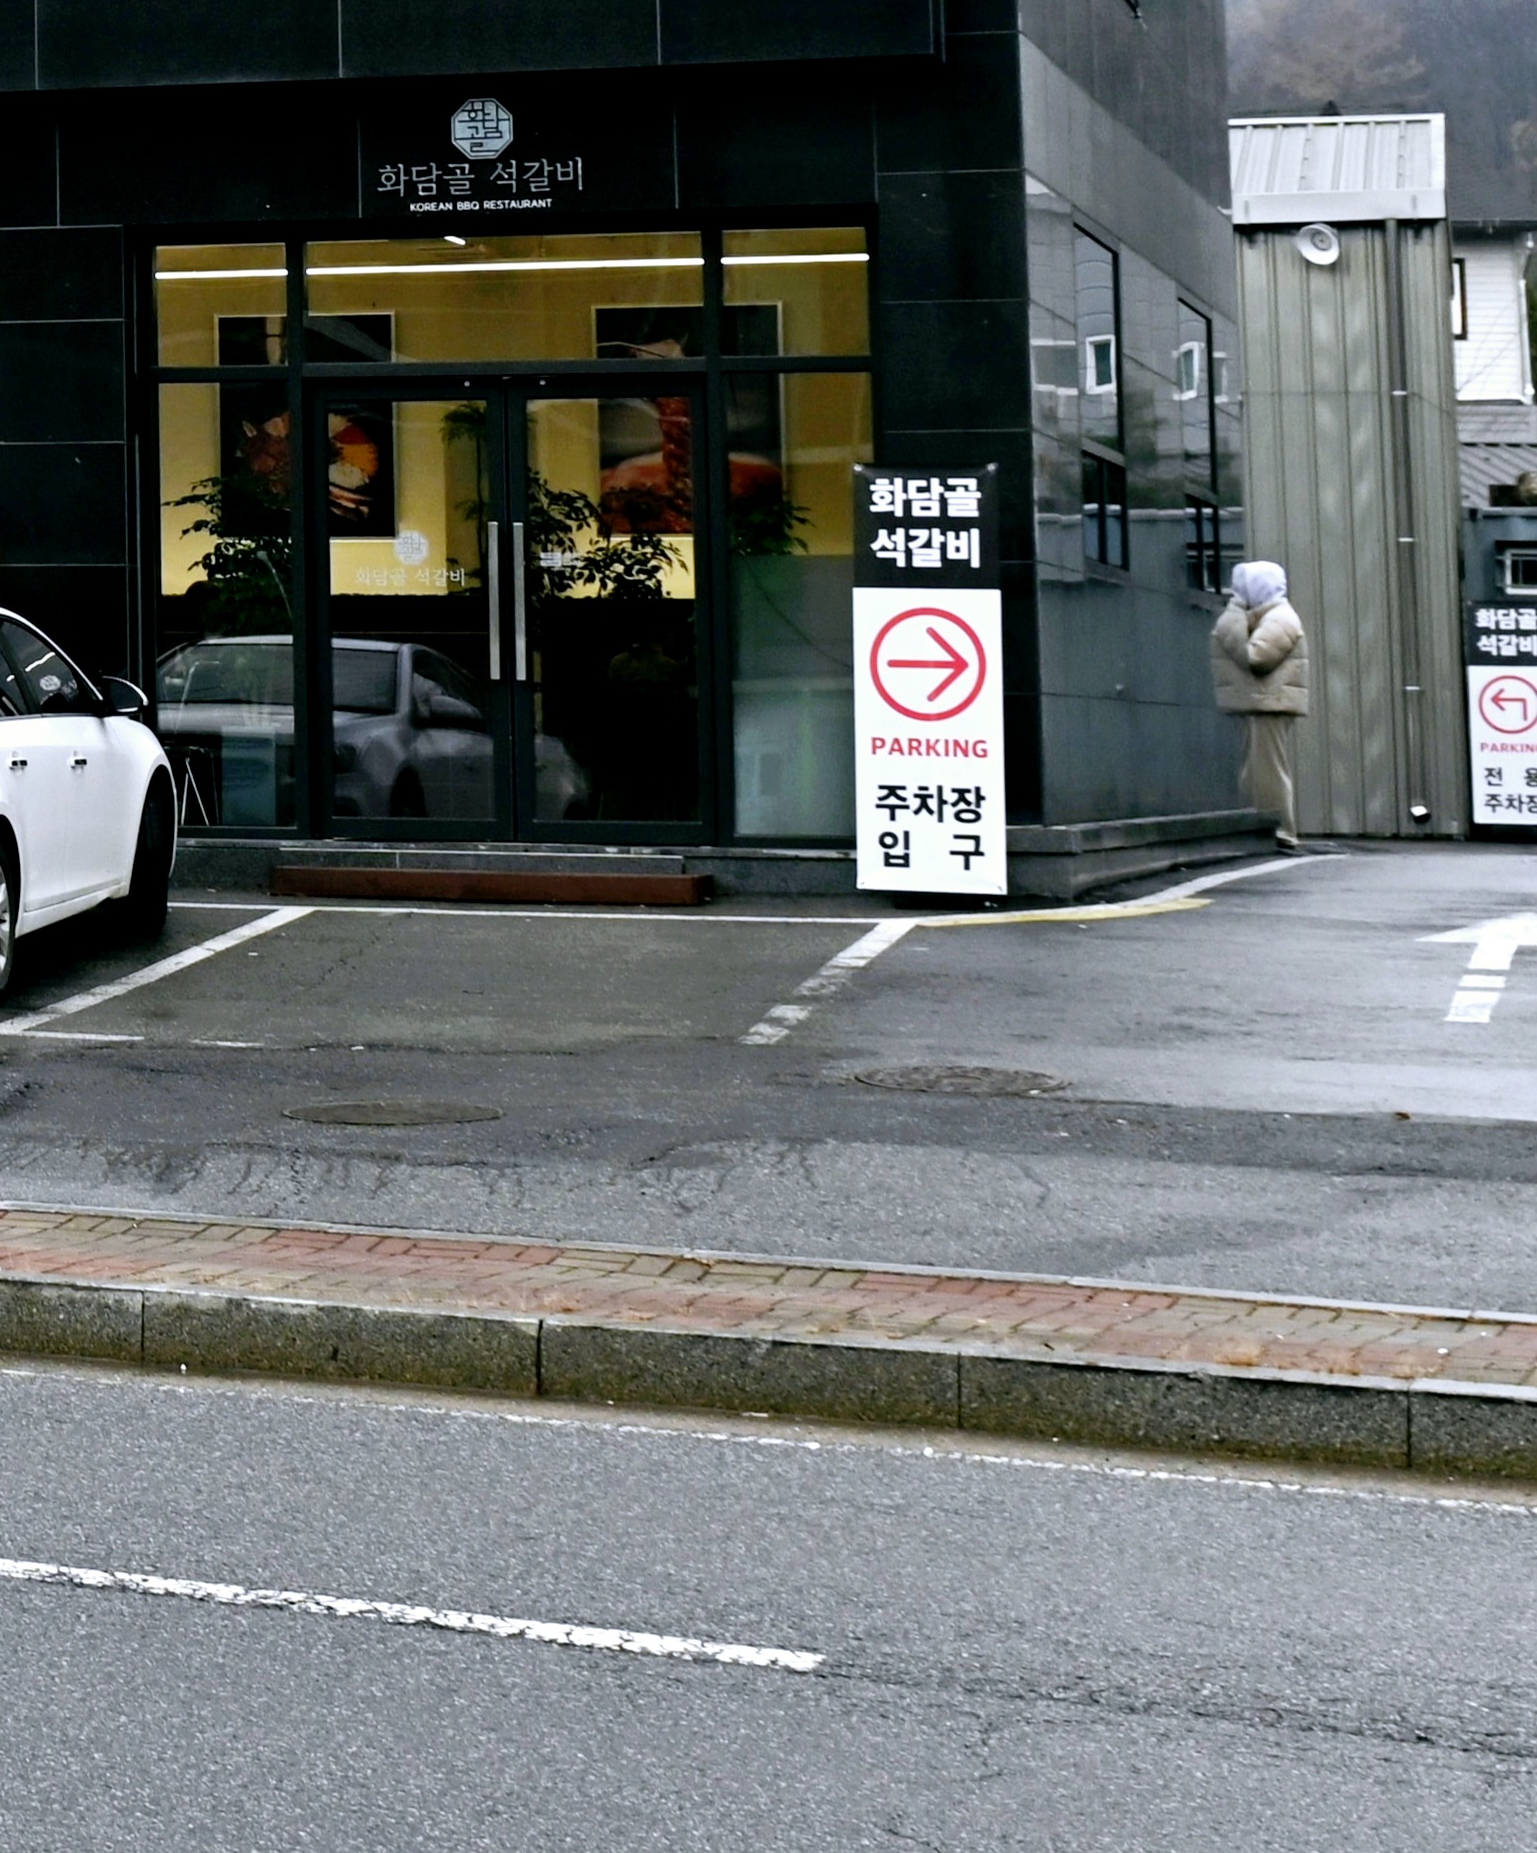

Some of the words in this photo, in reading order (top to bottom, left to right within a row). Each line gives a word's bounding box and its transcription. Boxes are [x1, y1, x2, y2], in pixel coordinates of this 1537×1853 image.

[377, 162, 475, 197] 화담골
[490, 157, 583, 193] 석갈비
[410, 202, 453, 212] KOREAN
[457, 200, 480, 211] BBQ
[483, 198, 552, 210] RESTAURANT
[869, 477, 982, 518] 화담골
[869, 527, 981, 568] 석갈비
[1476, 608, 1537, 630] 화담골
[871, 737, 988, 759] PARKING
[1480, 742, 1537, 753] PARKIN
[875, 784, 986, 824] 주차장
